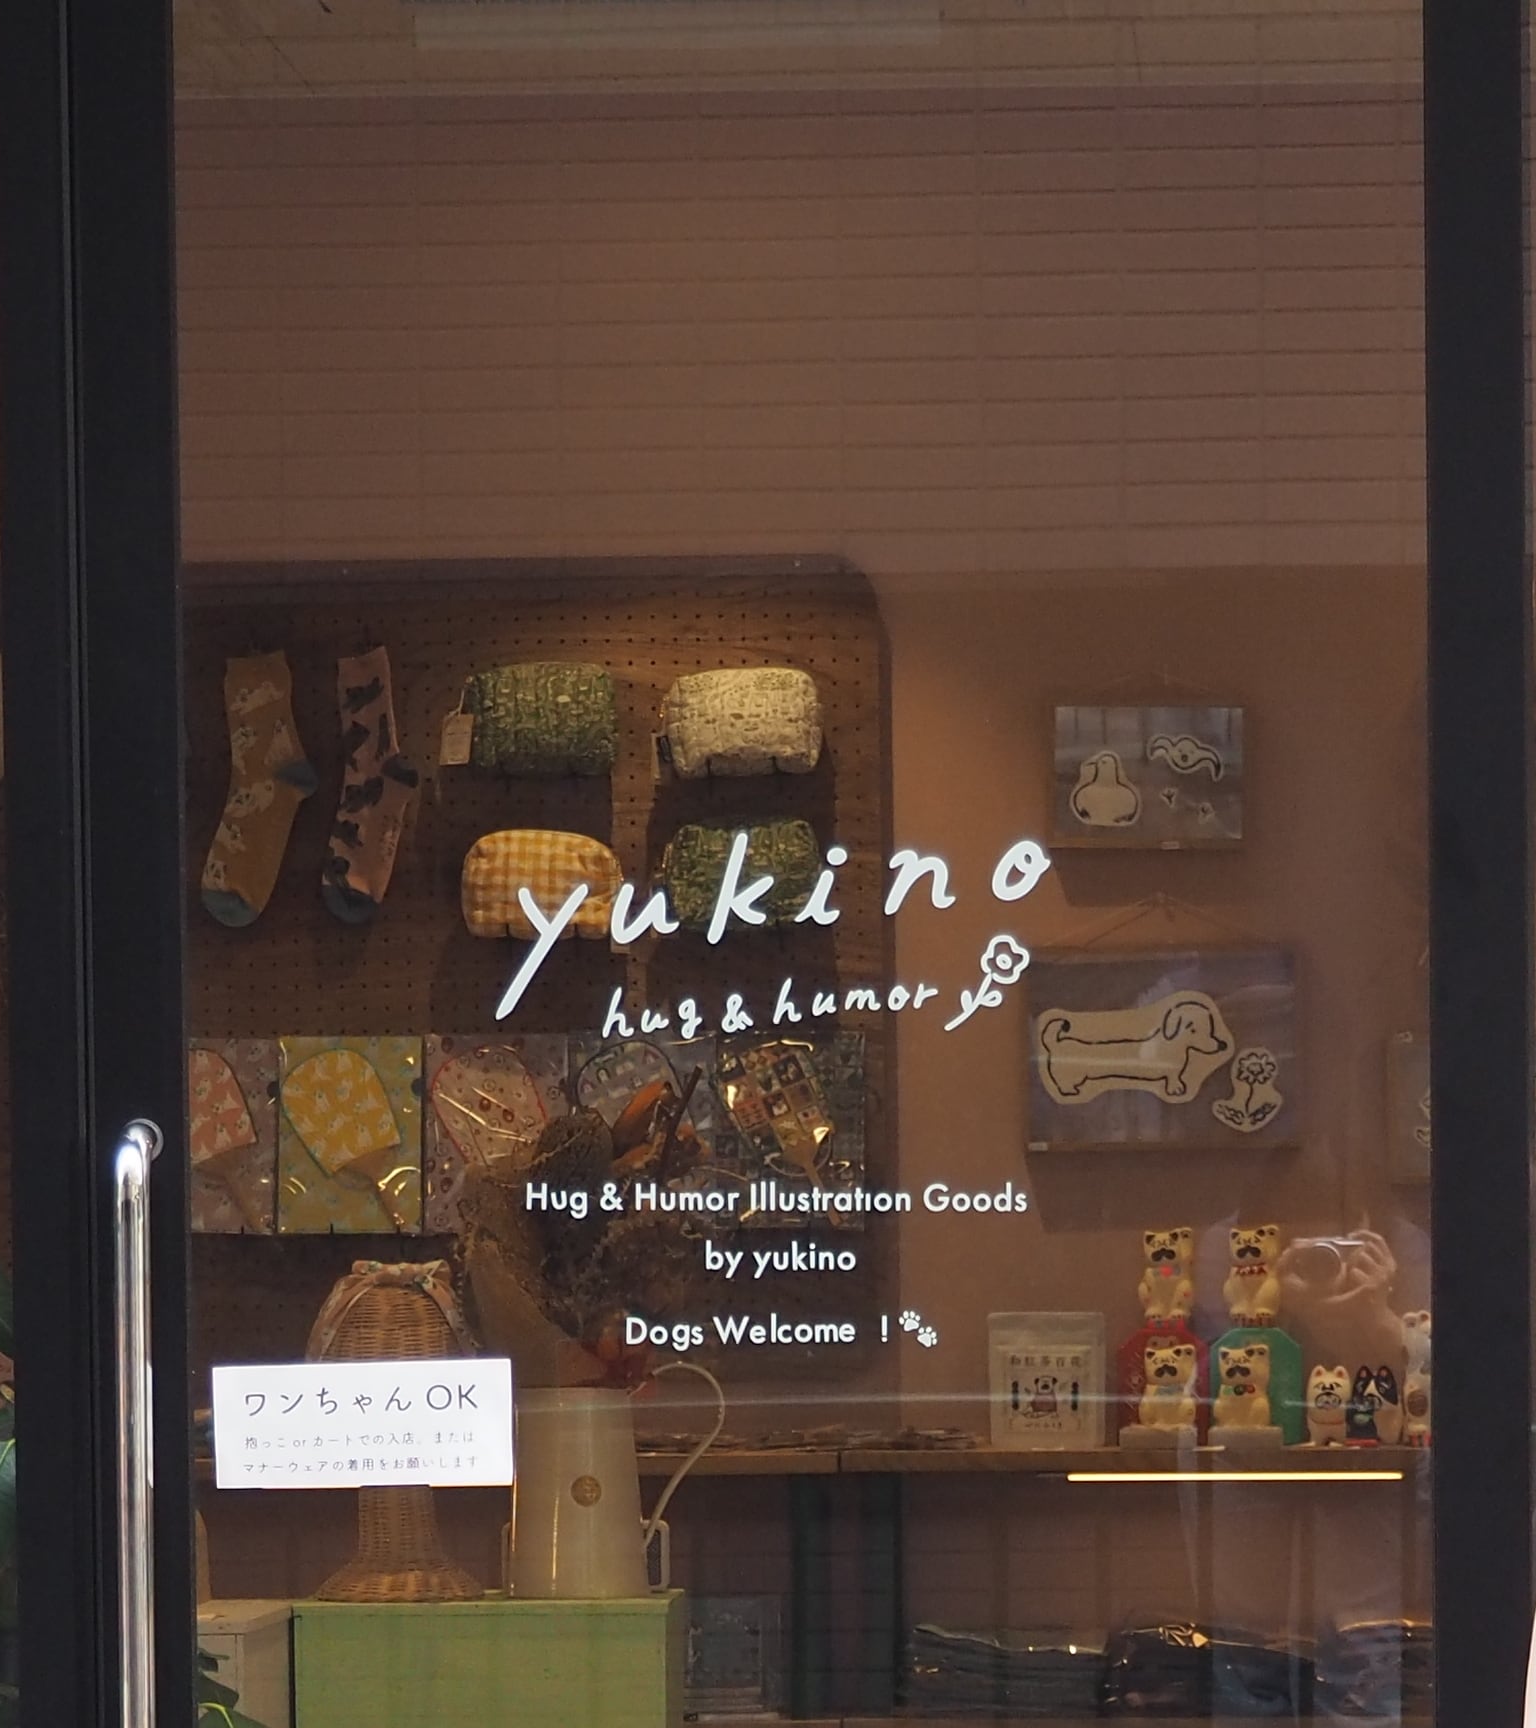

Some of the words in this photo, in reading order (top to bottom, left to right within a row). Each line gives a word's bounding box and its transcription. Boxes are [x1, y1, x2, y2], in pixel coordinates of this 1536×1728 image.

[497, 833, 1051, 1020] yukino
[602, 986, 701, 1040] hug
[720, 993, 754, 1034] &
[772, 977, 940, 1026] humor
[526, 1183, 589, 1219] Hug
[601, 1183, 625, 1212] &
[636, 1184, 741, 1212] Humor
[748, 1182, 912, 1213] Illustration
[924, 1182, 1028, 1213] Goods
[705, 1240, 744, 1279] by
[754, 1242, 857, 1279] yukino
[626, 1317, 705, 1352] Dogs
[714, 1314, 857, 1346] Welcome
